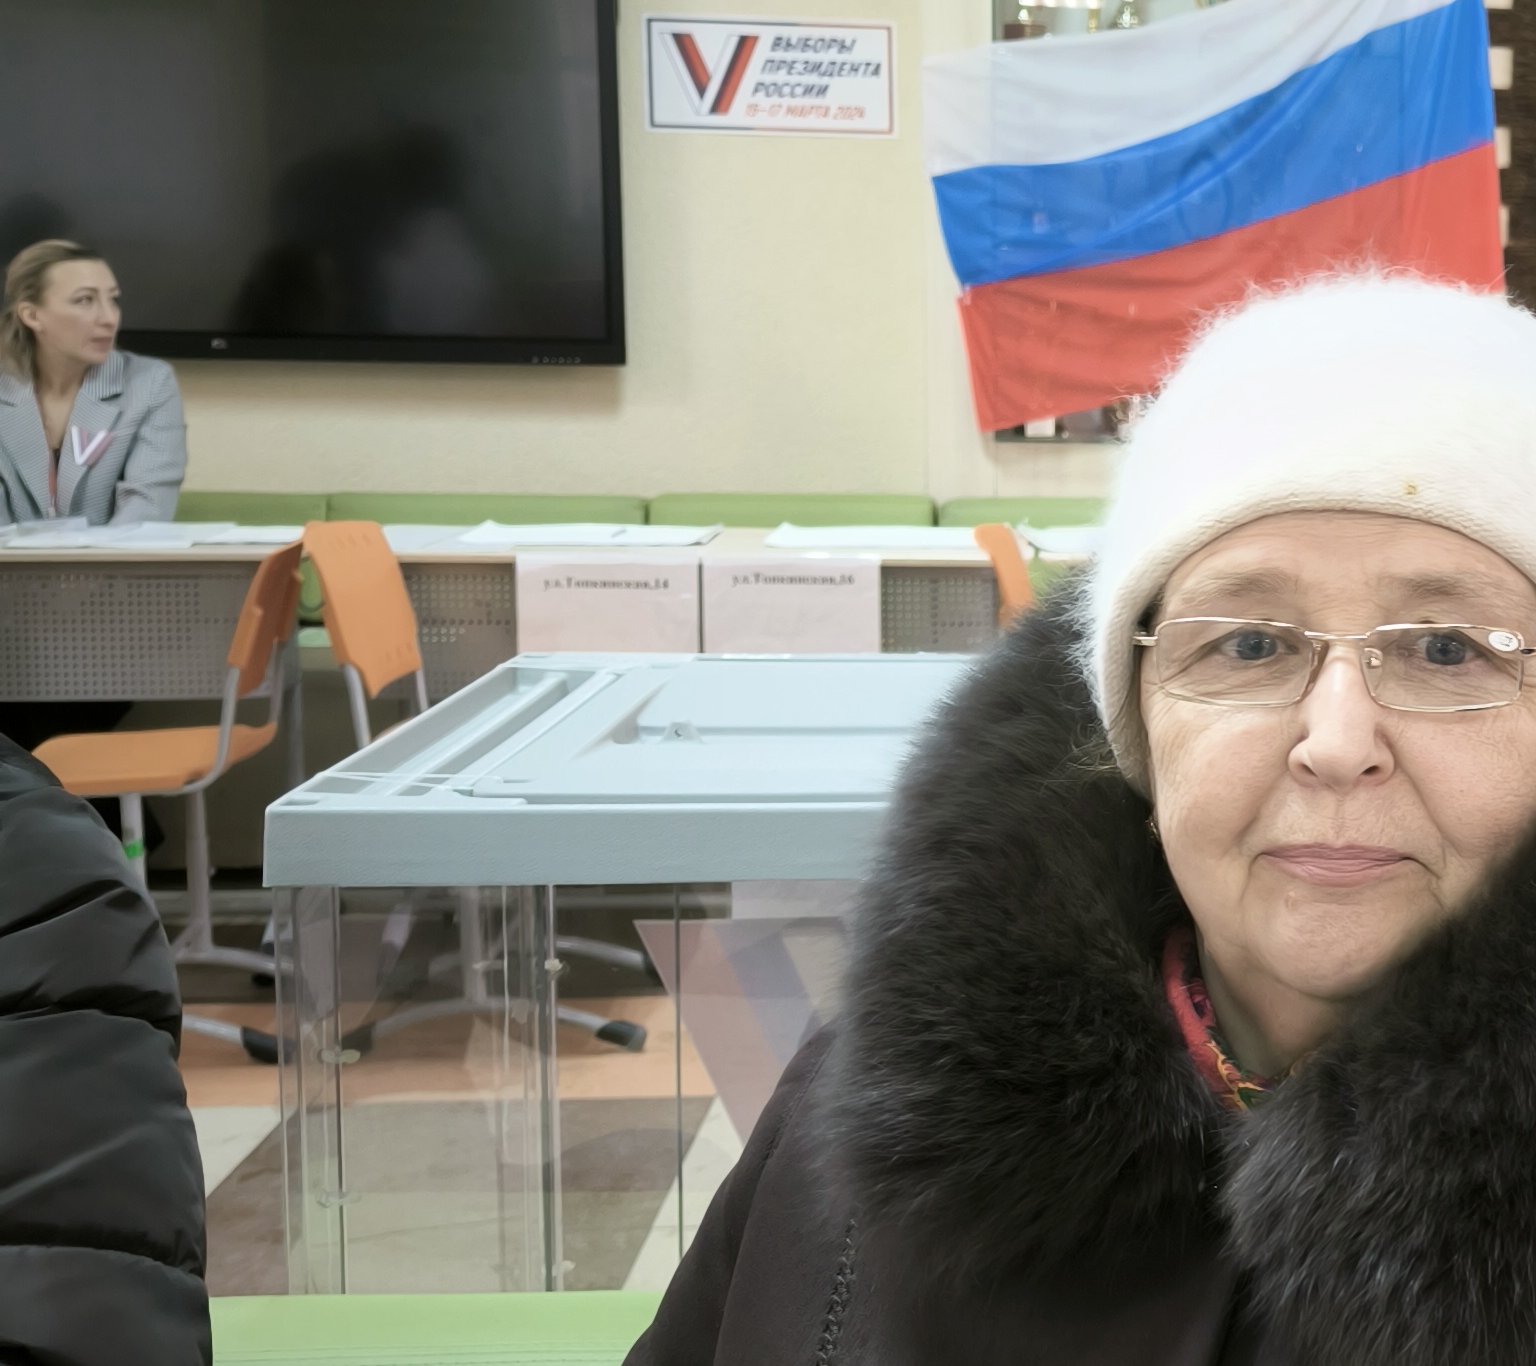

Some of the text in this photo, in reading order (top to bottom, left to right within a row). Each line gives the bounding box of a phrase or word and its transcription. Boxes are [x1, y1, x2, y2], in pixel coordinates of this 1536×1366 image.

[769, 36, 857, 54] ВЫБОРЫ
[759, 59, 882, 79] ПРЕЗИДЕНТА
[751, 81, 830, 100] РОССИИ
[783, 104, 831, 120] МАРТА
